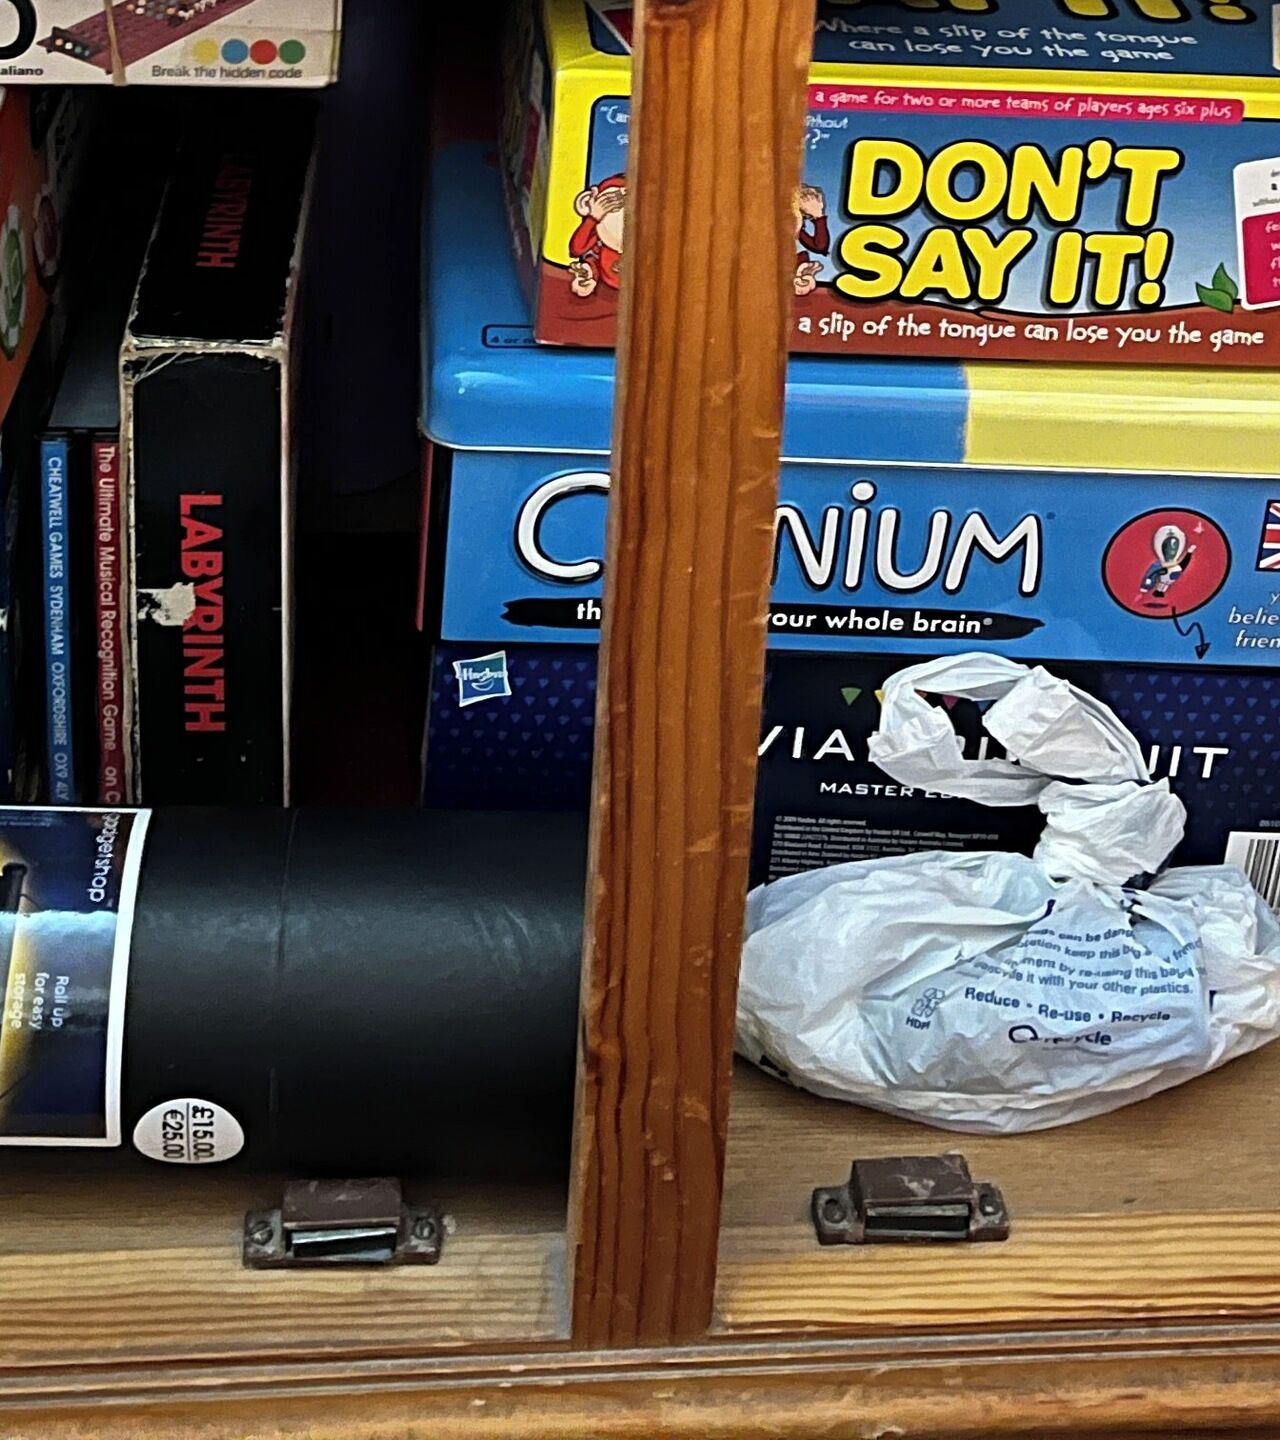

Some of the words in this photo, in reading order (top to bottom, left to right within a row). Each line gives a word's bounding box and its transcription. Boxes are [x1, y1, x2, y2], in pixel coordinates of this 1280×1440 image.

[847, 138, 1179, 227] DON'T
[837, 227, 1031, 302] SAY
[1049, 230, 1169, 307] IT!
[799, 317, 811, 335] a
[819, 314, 855, 341] slip
[864, 312, 892, 338] of
[897, 317, 931, 339] the
[939, 318, 1015, 344] tongue
[1024, 322, 1060, 342] can
[1066, 320, 1108, 343] lose
[1116, 325, 1161, 348] you
[1169, 323, 1201, 345] the
[1210, 326, 1264, 351] game
[97, 446, 115, 473] The
[47, 456, 62, 529] CHEATWELL
[99, 476, 113, 542] Ultimate
[49, 531, 63, 578] GAMES
[100, 546, 115, 610] Musical
[50, 585, 64, 655] SYDENHAM
[179, 494, 225, 731] LABYRINTH
[824, 611, 905, 632] whole
[98, 612, 116, 701] Recognition
[51, 662, 67, 745] OXFORDSHIRE
[54, 752, 68, 778] OX9
[105, 766, 116, 786] on
[821, 782, 914, 798] MASTER
[965, 987, 1020, 1008] Reduce
[1038, 1004, 1092, 1022] Re-use
[1111, 1010, 1171, 1022] Recycle
[162, 1109, 185, 1159] €25.00
[191, 1106, 214, 1160] £15.00
